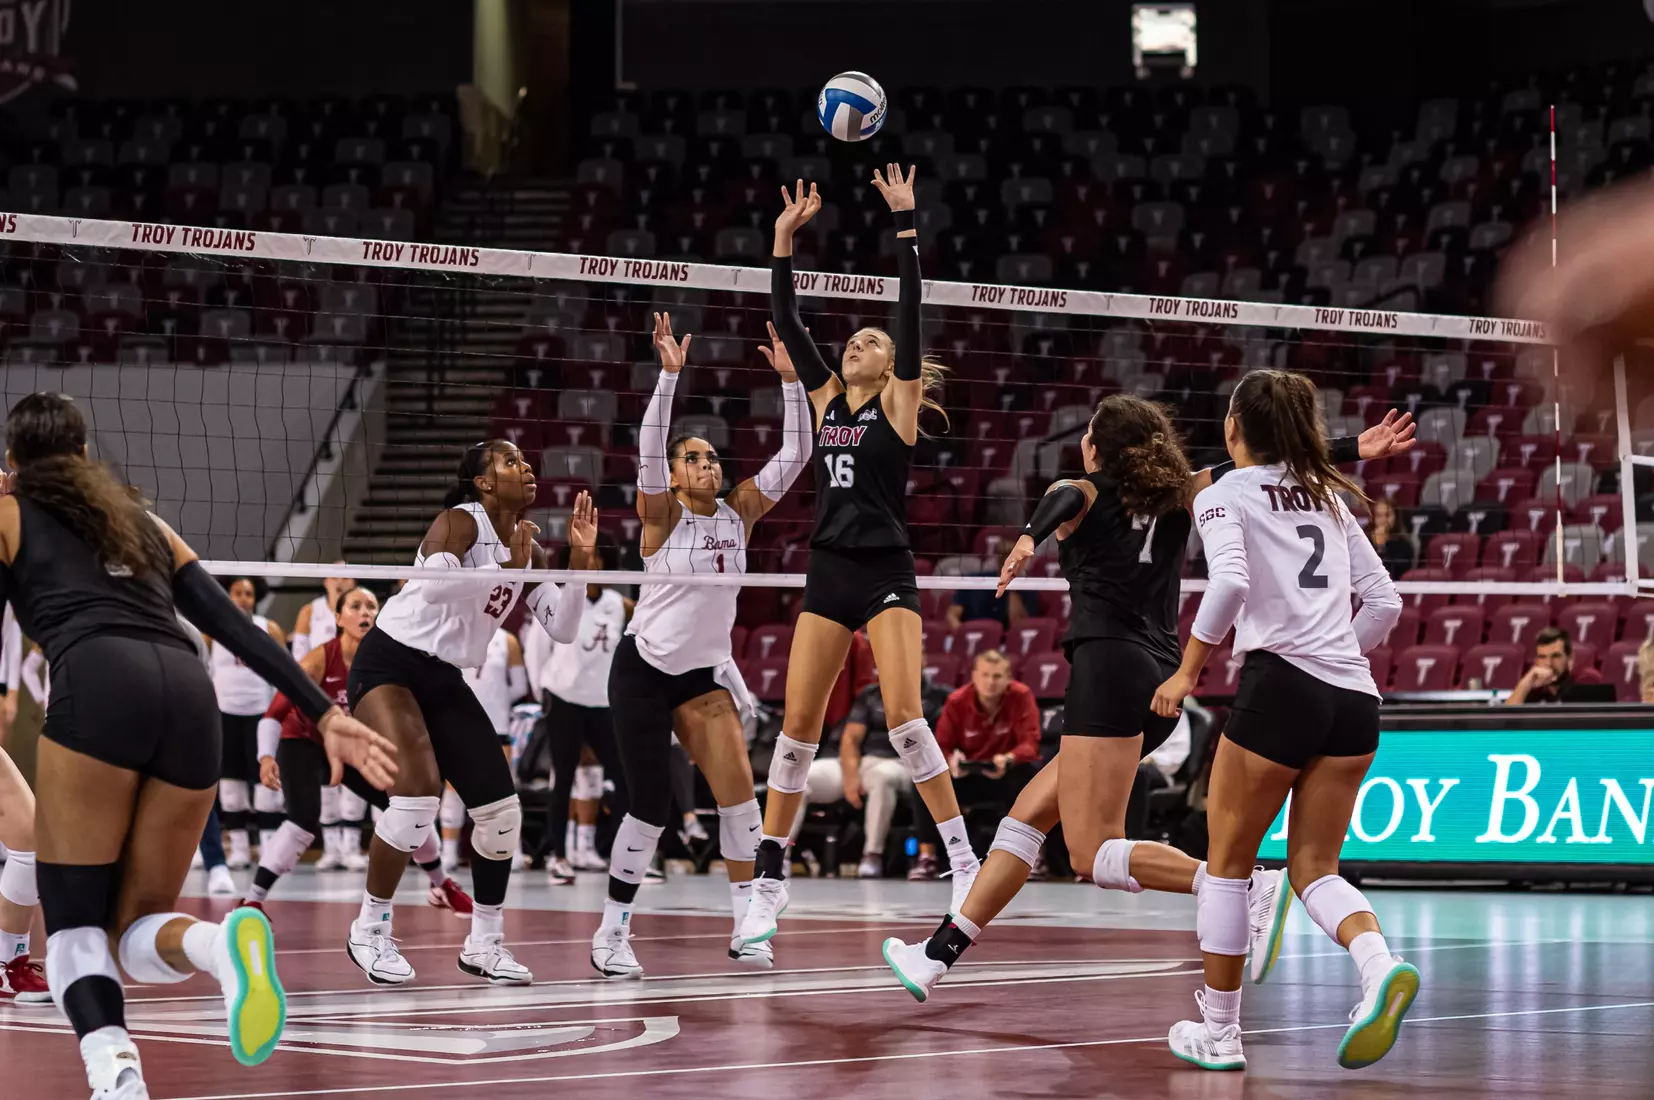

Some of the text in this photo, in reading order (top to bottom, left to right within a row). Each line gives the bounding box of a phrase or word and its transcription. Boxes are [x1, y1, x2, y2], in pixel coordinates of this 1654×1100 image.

[132, 224, 256, 251] TROY TROJANS
[363, 241, 480, 267] TROY TROJANS
[579, 256, 689, 282] TROY TROJANS
[792, 274, 884, 296] ROY TROJANS
[972, 285, 1067, 308] TROY TROJANS
[1150, 298, 1238, 319] TROY TROJANS
[1315, 309, 1398, 329] TROY TROJANS
[1469, 319, 1546, 339] TROY TROJANS
[819, 425, 868, 447] TROY
[824, 453, 855, 488] 16
[701, 535, 737, 551] Bama
[1131, 513, 1157, 564] 7
[716, 553, 725, 574] 1
[1296, 524, 1328, 589] 2
[483, 584, 514, 619] 23
[1271, 753, 1654, 844] OY BAN
